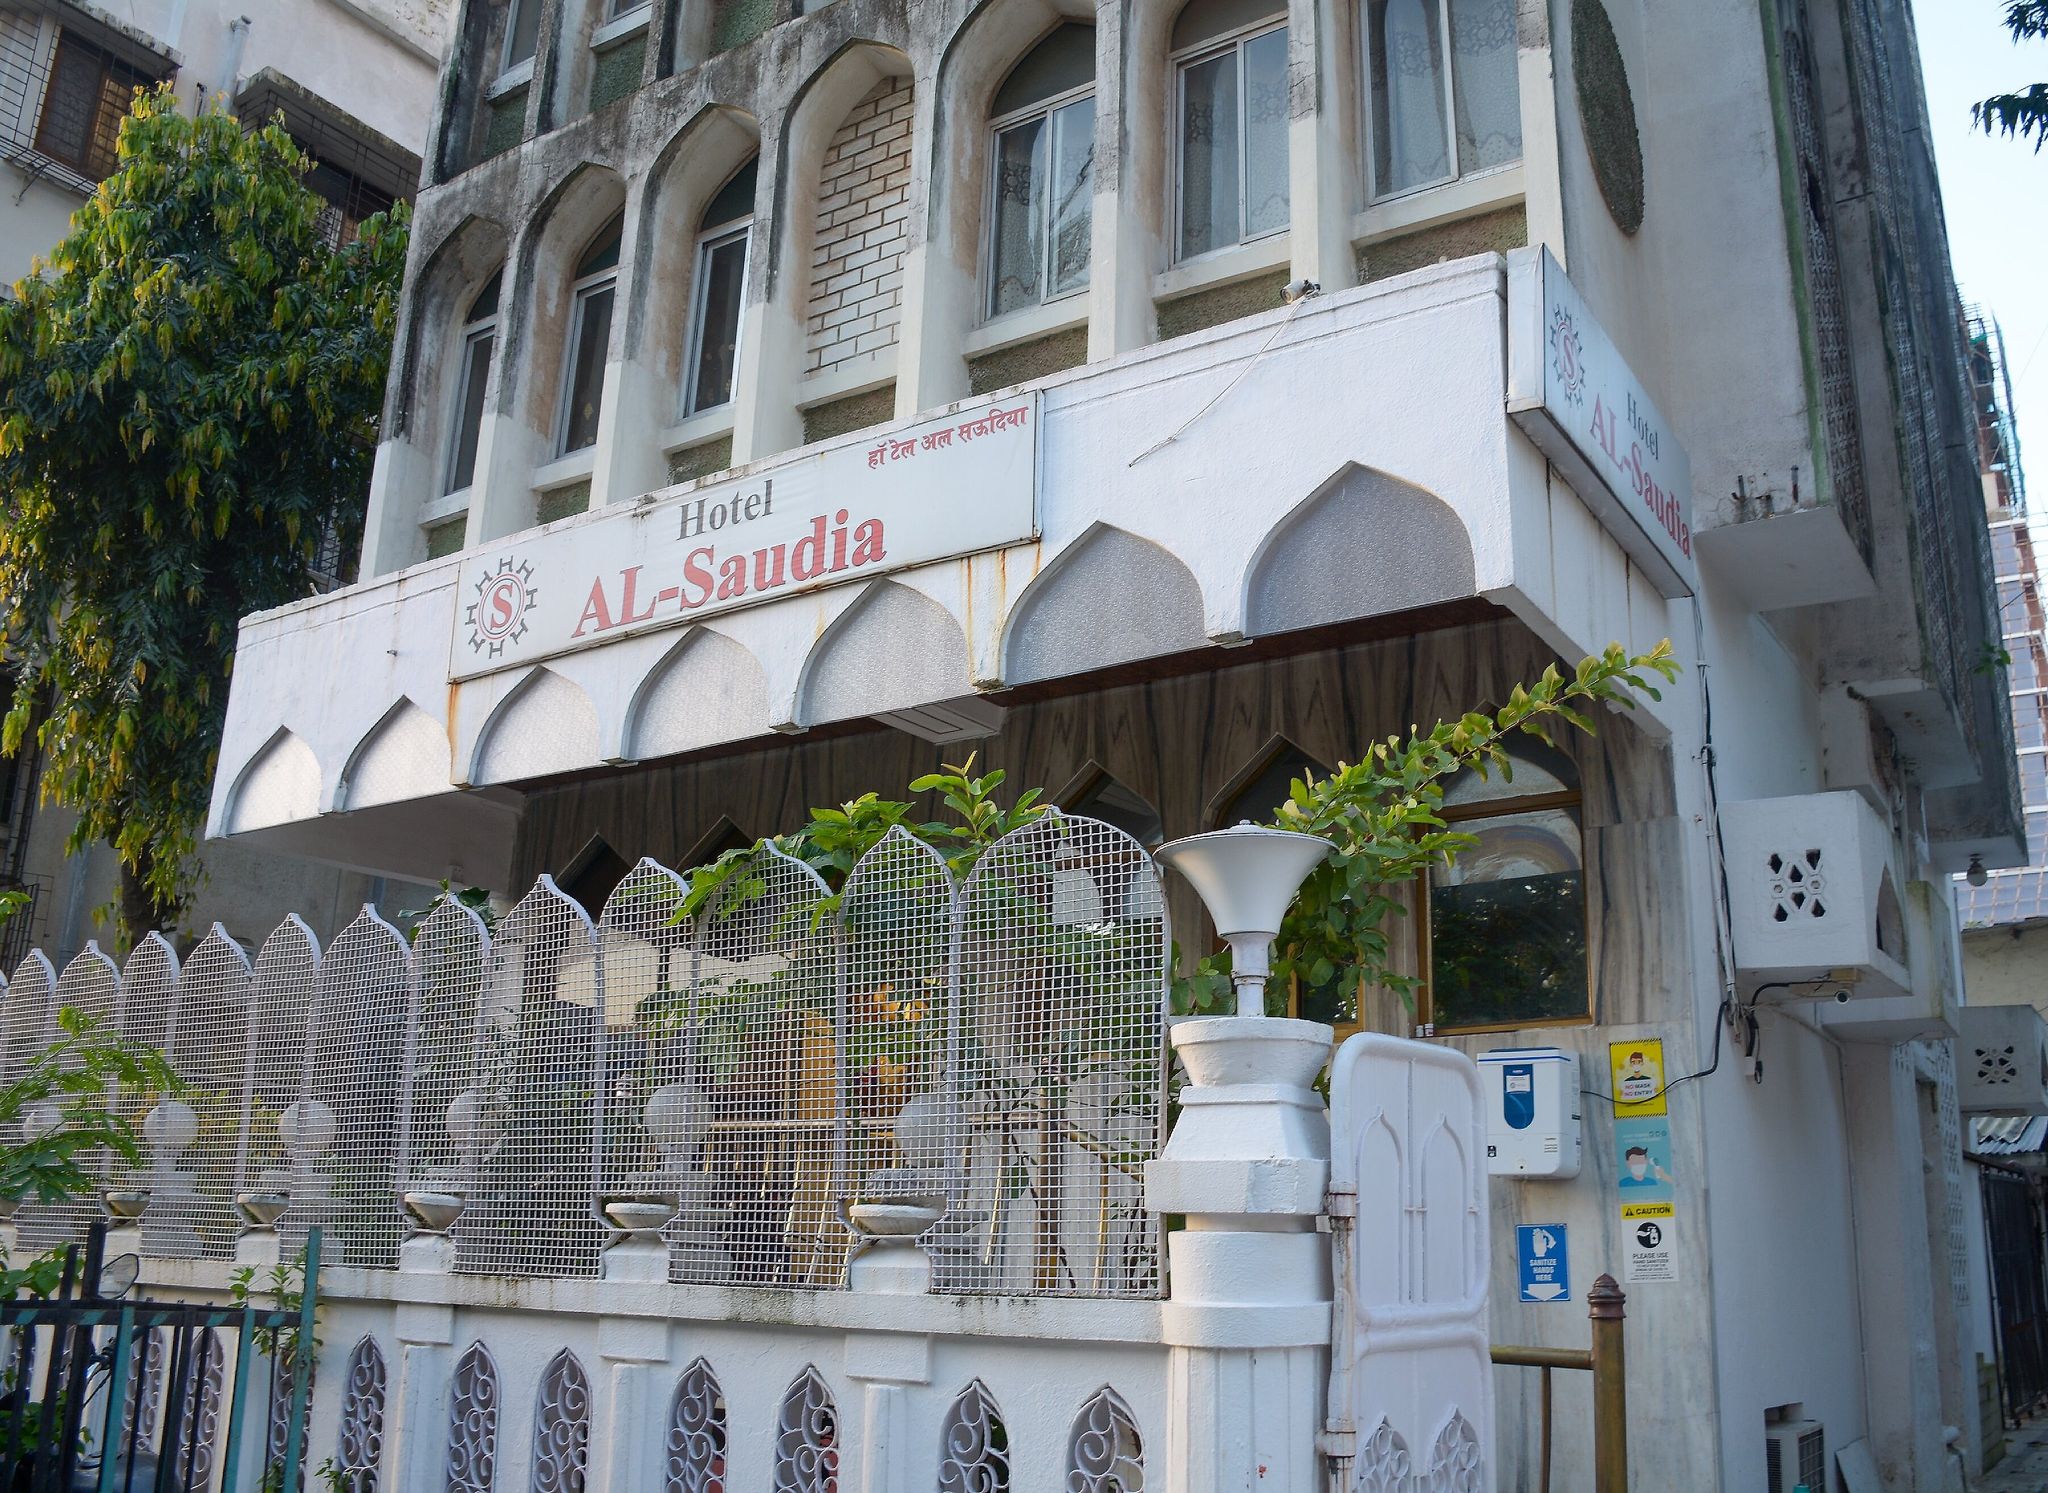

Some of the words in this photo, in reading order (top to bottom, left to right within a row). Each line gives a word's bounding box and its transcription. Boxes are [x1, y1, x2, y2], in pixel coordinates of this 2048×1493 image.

[921, 427, 954, 450] अल
[958, 406, 1029, 443] सऊदिया
[1627, 391, 1658, 460] Hotel
[1589, 393, 1691, 560] AL-Saudia
[676, 479, 775, 541] Hotel
[572, 507, 887, 639] AL-Saudia
[490, 582, 513, 630] S
[1635, 1206, 1671, 1215] CAUTION
[1530, 1258, 1557, 1266] SANITIZE
[1632, 1252, 1655, 1260] PLEASE
